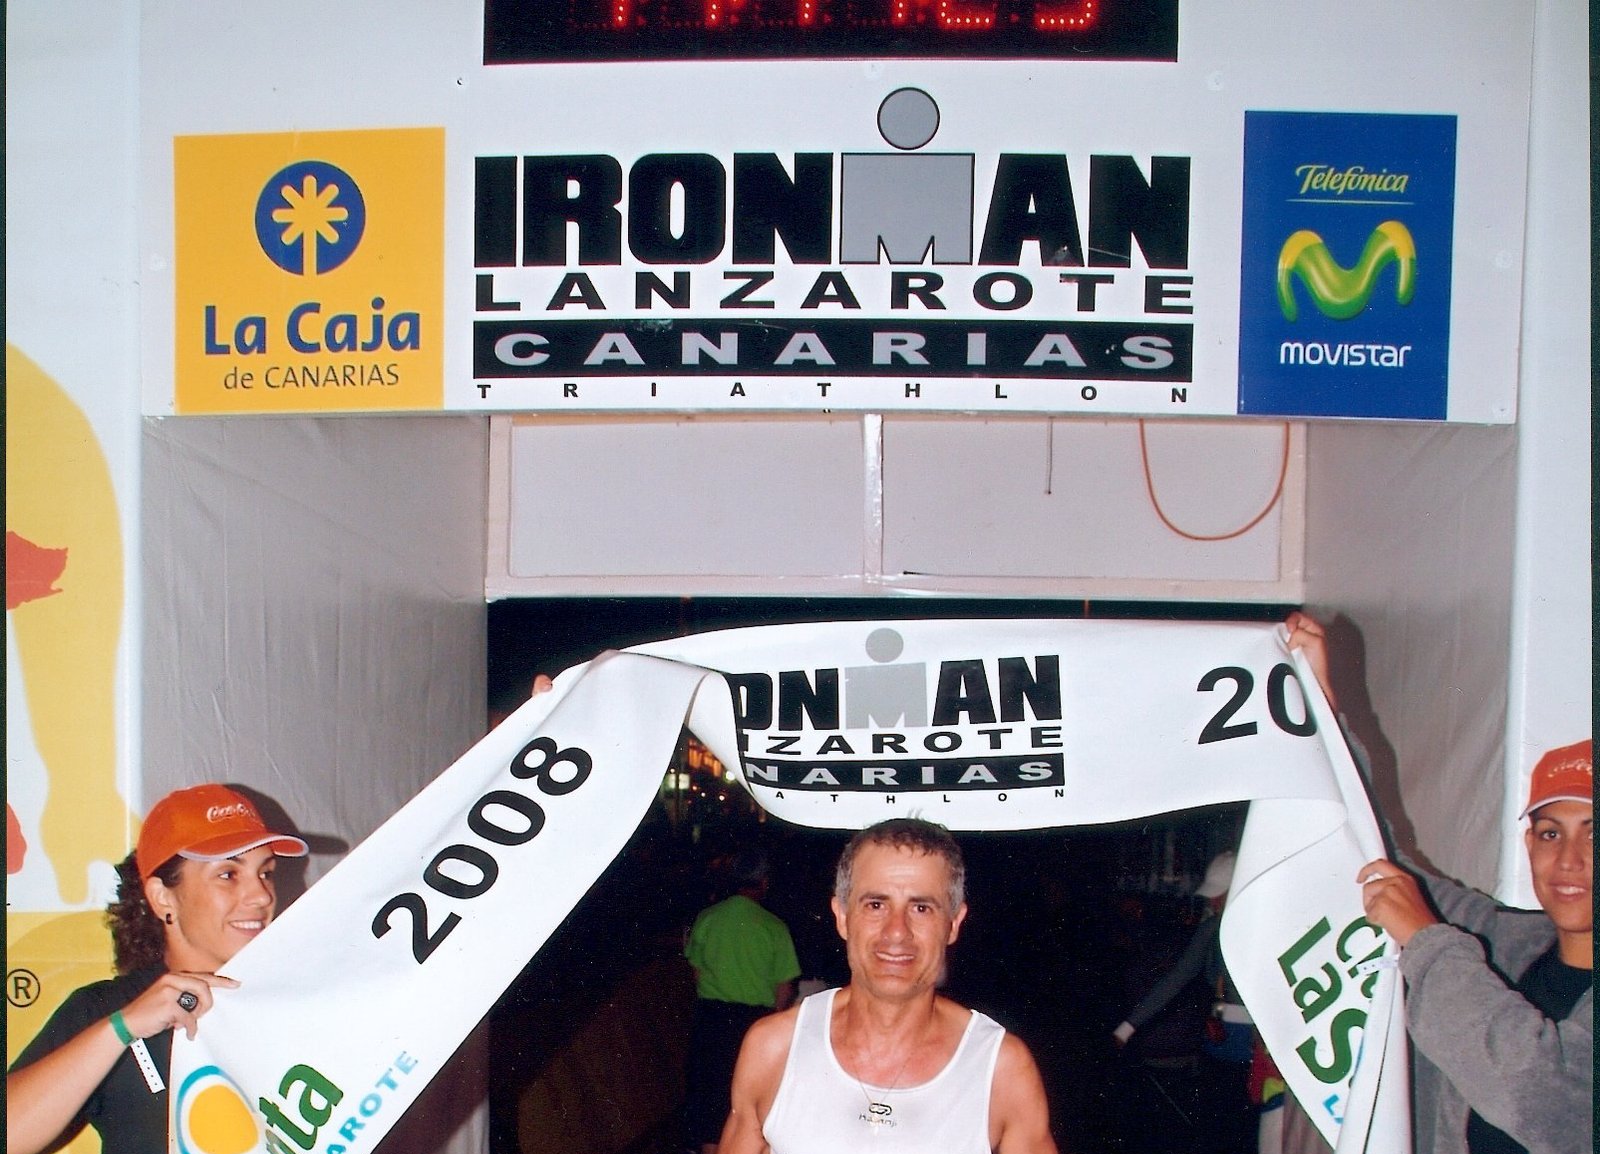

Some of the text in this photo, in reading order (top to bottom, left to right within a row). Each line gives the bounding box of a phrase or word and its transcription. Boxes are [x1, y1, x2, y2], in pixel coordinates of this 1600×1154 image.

[474, 152, 1191, 268] IRONMAN
[475, 271, 1194, 315] LANZAROTE
[204, 297, 420, 355] La Caja
[494, 332, 1174, 370] CANARIAS
[223, 364, 399, 390] de CANARIAS
[477, 381, 1187, 403] TRIATHLON
[371, 736, 592, 965] 2008
